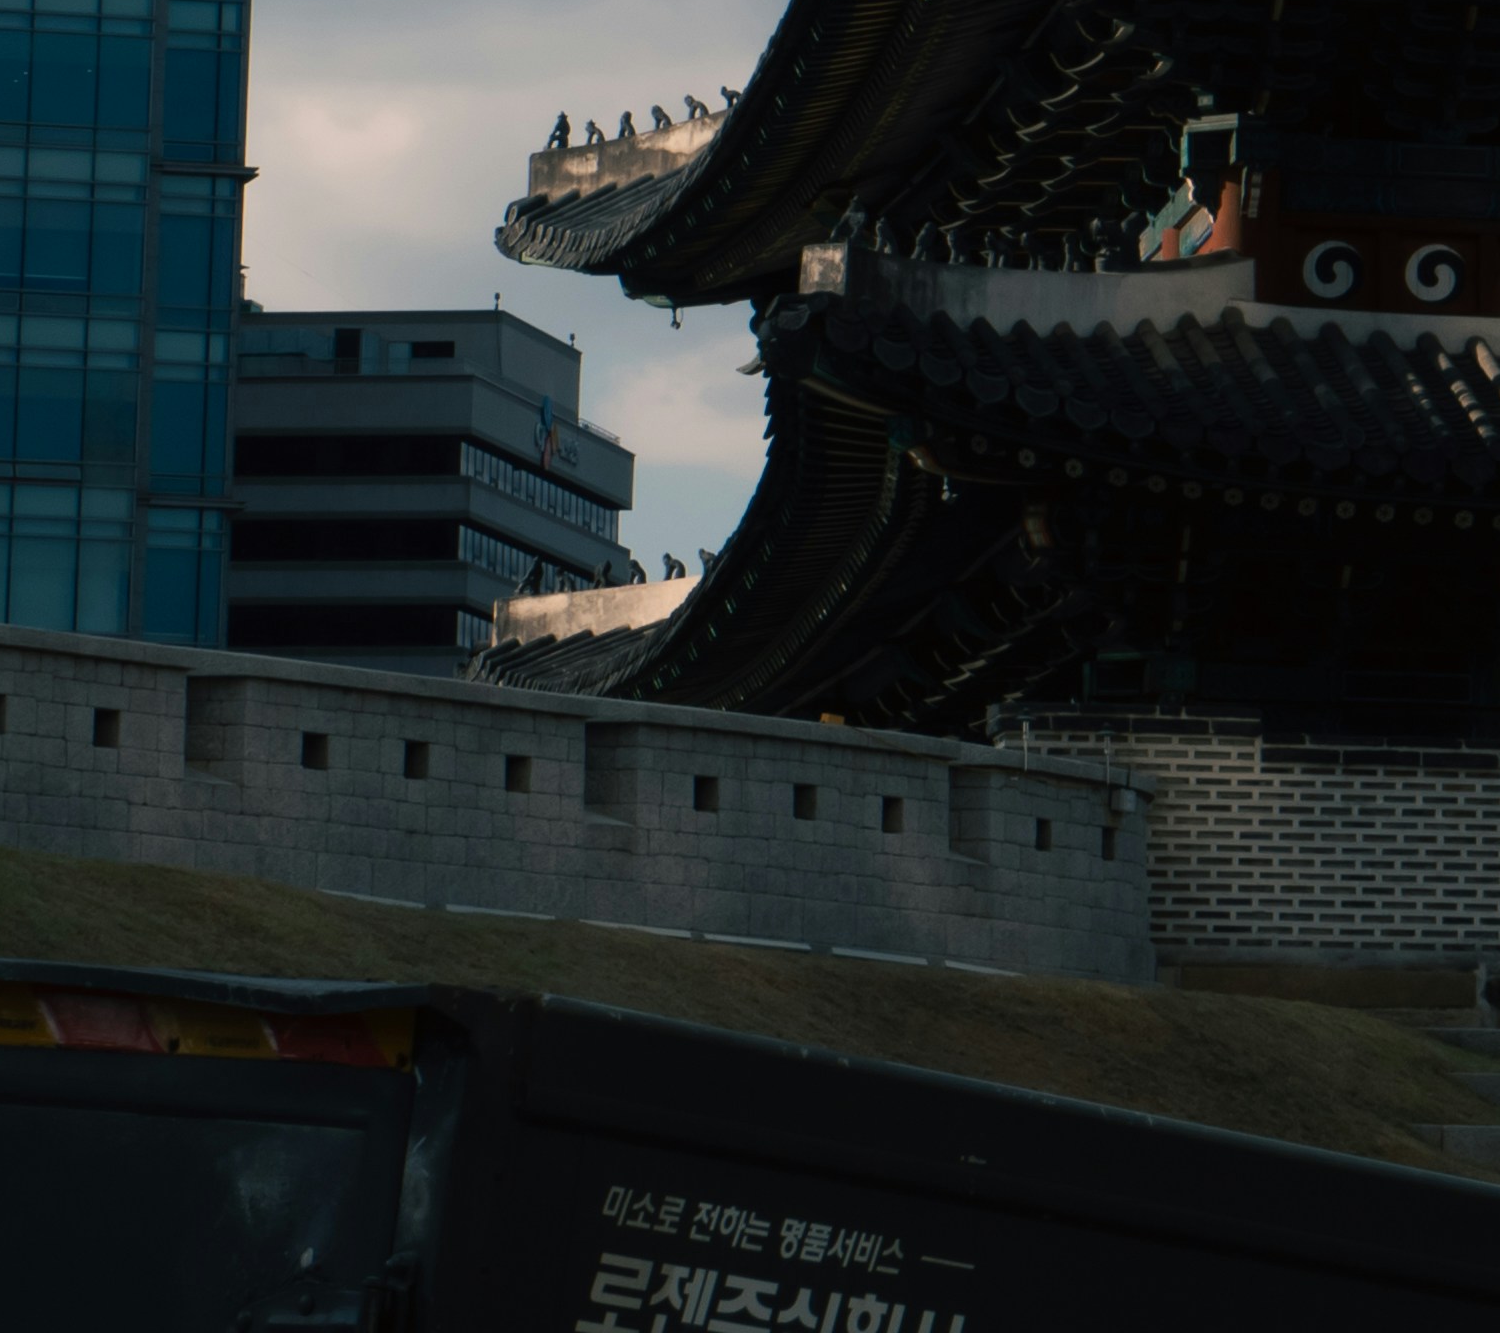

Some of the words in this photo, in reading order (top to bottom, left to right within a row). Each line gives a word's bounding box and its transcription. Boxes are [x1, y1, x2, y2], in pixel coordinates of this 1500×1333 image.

[602, 1185, 685, 1234] 미소로
[689, 1201, 771, 1252] 전하는
[779, 1216, 905, 1275] 명품서비스
